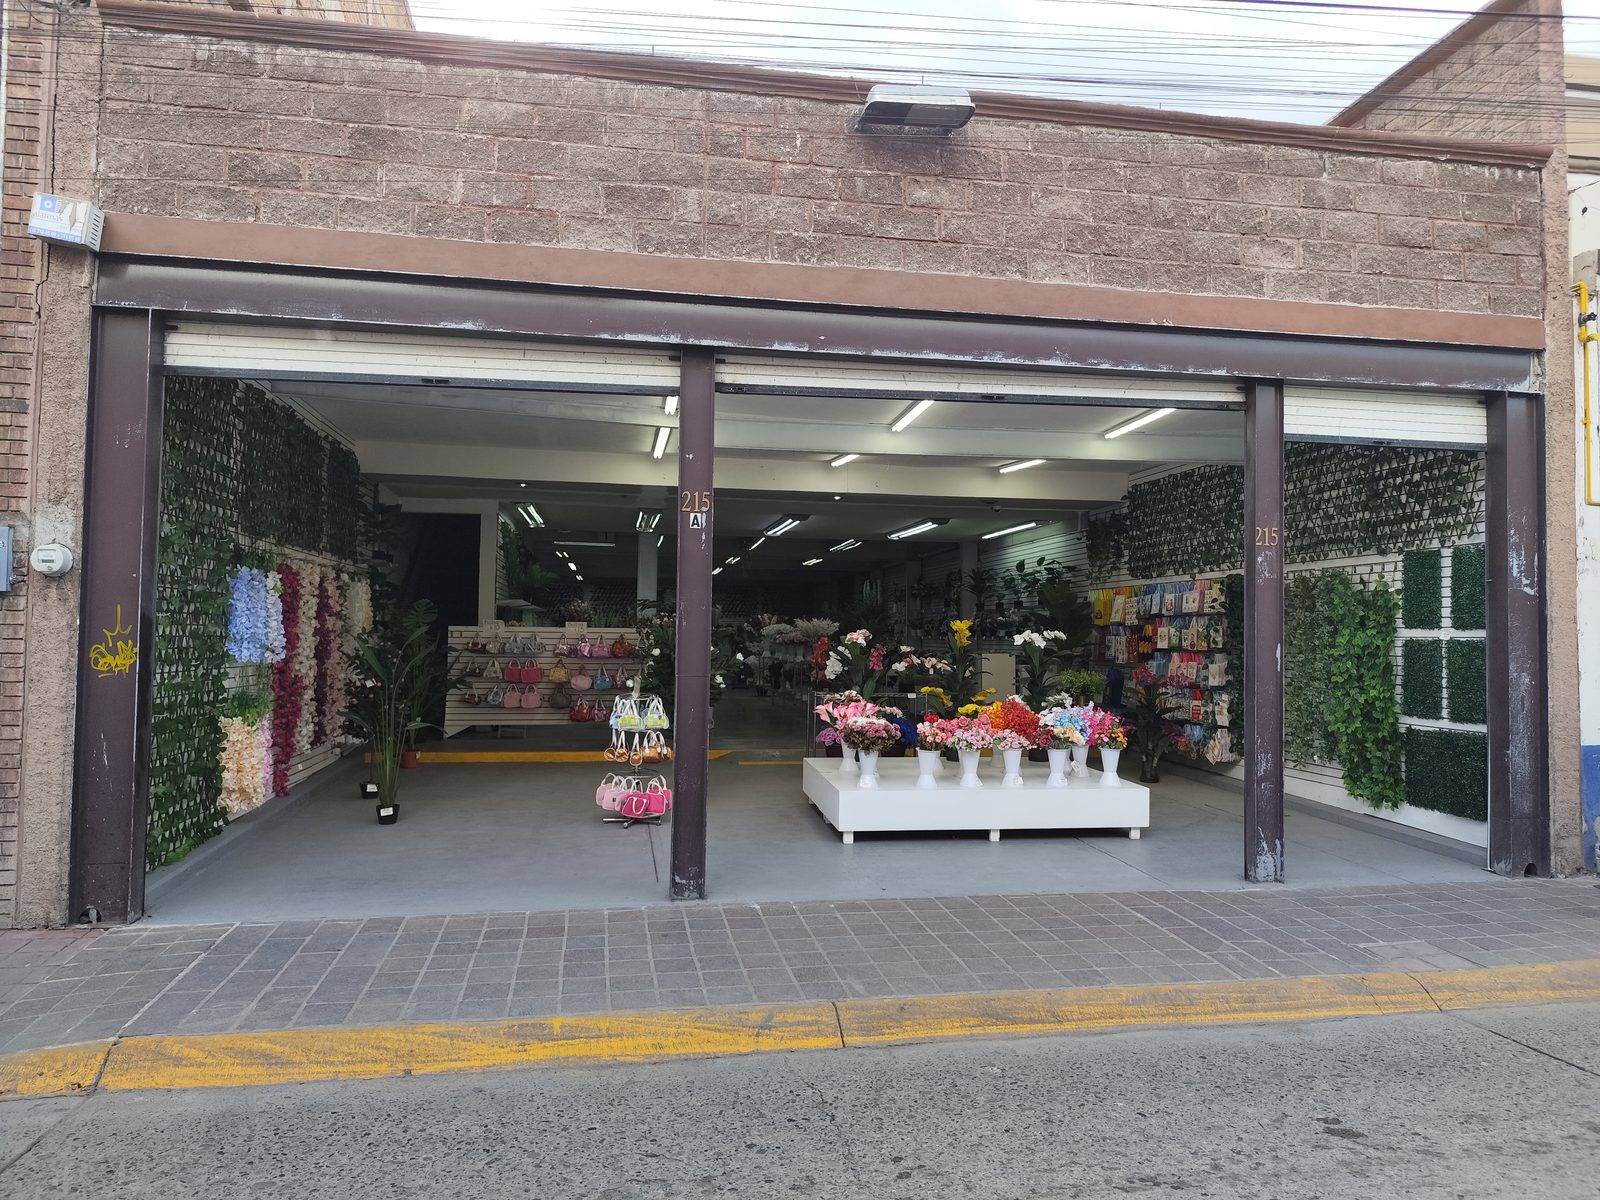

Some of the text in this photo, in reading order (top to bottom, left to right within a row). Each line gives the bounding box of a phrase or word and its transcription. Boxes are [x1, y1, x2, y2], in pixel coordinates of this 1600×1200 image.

[681, 491, 711, 512] 215
[691, 514, 700, 527] A
[1255, 527, 1279, 546] 215
